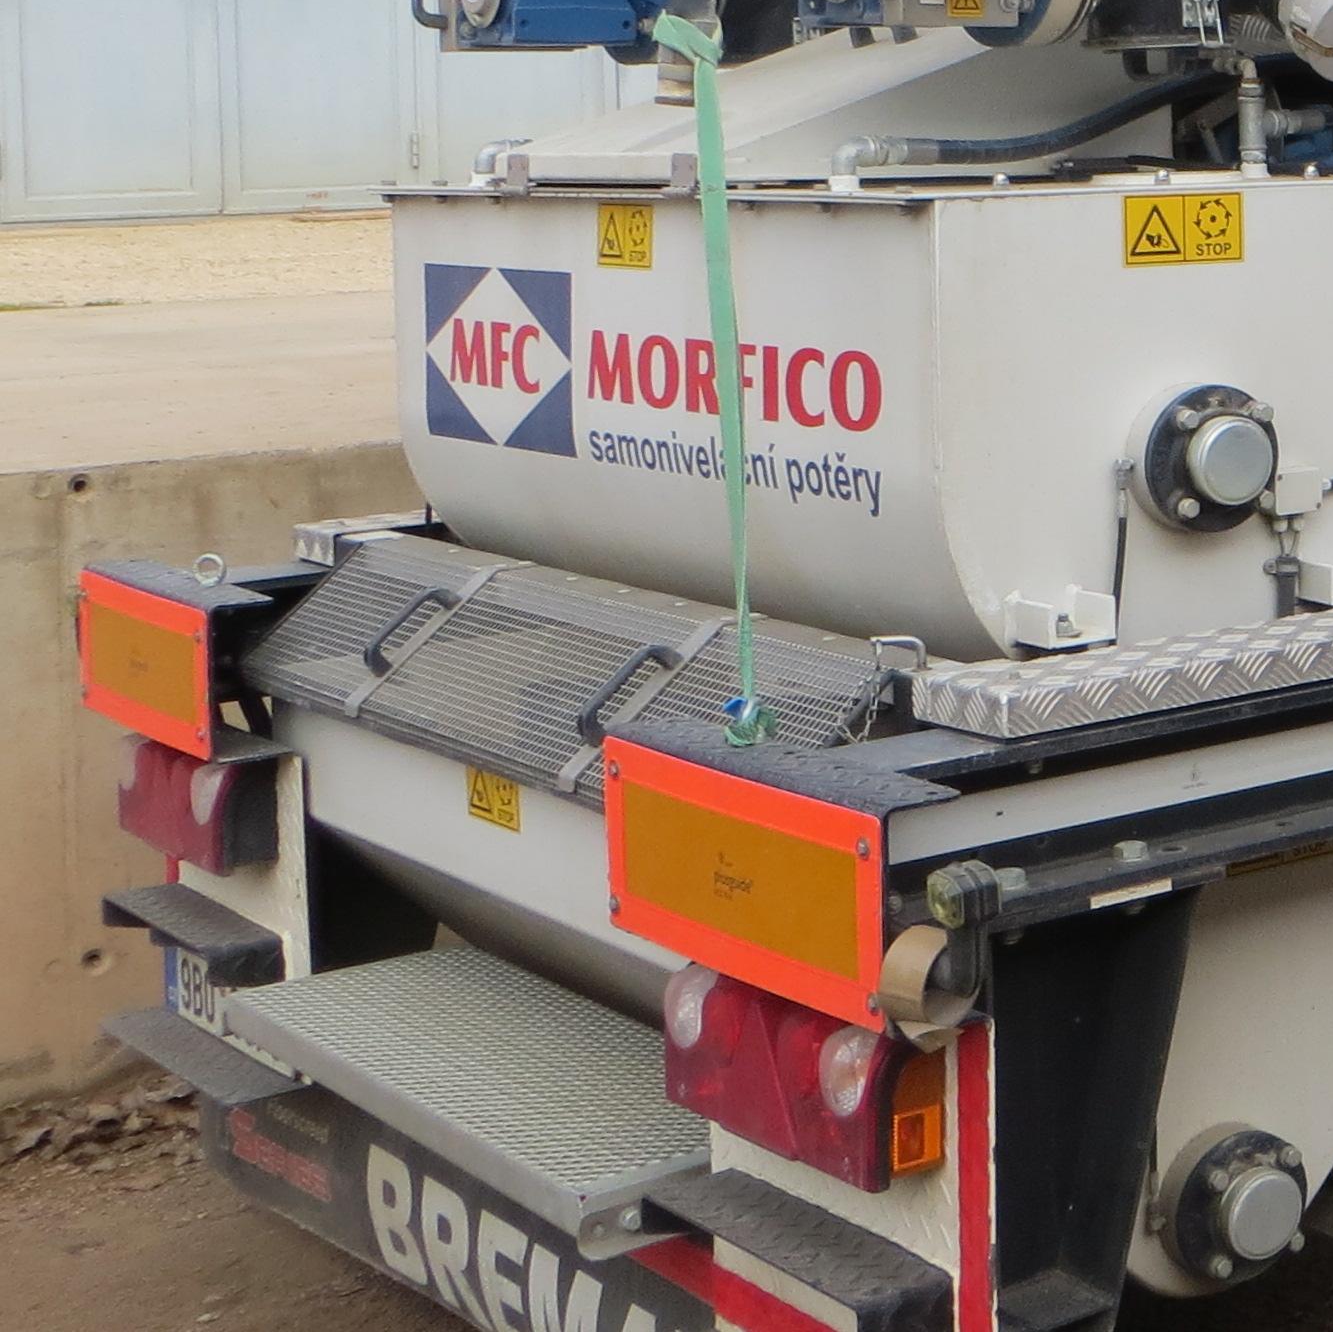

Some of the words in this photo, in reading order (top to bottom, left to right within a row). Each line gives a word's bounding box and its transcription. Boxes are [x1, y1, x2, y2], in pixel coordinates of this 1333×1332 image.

[1196, 243, 1232, 256] STOP
[450, 318, 540, 395] MFC
[589, 429, 779, 490] samonivelní
[785, 452, 881, 518] potěry
[366, 1143, 682, 1332] BREM
